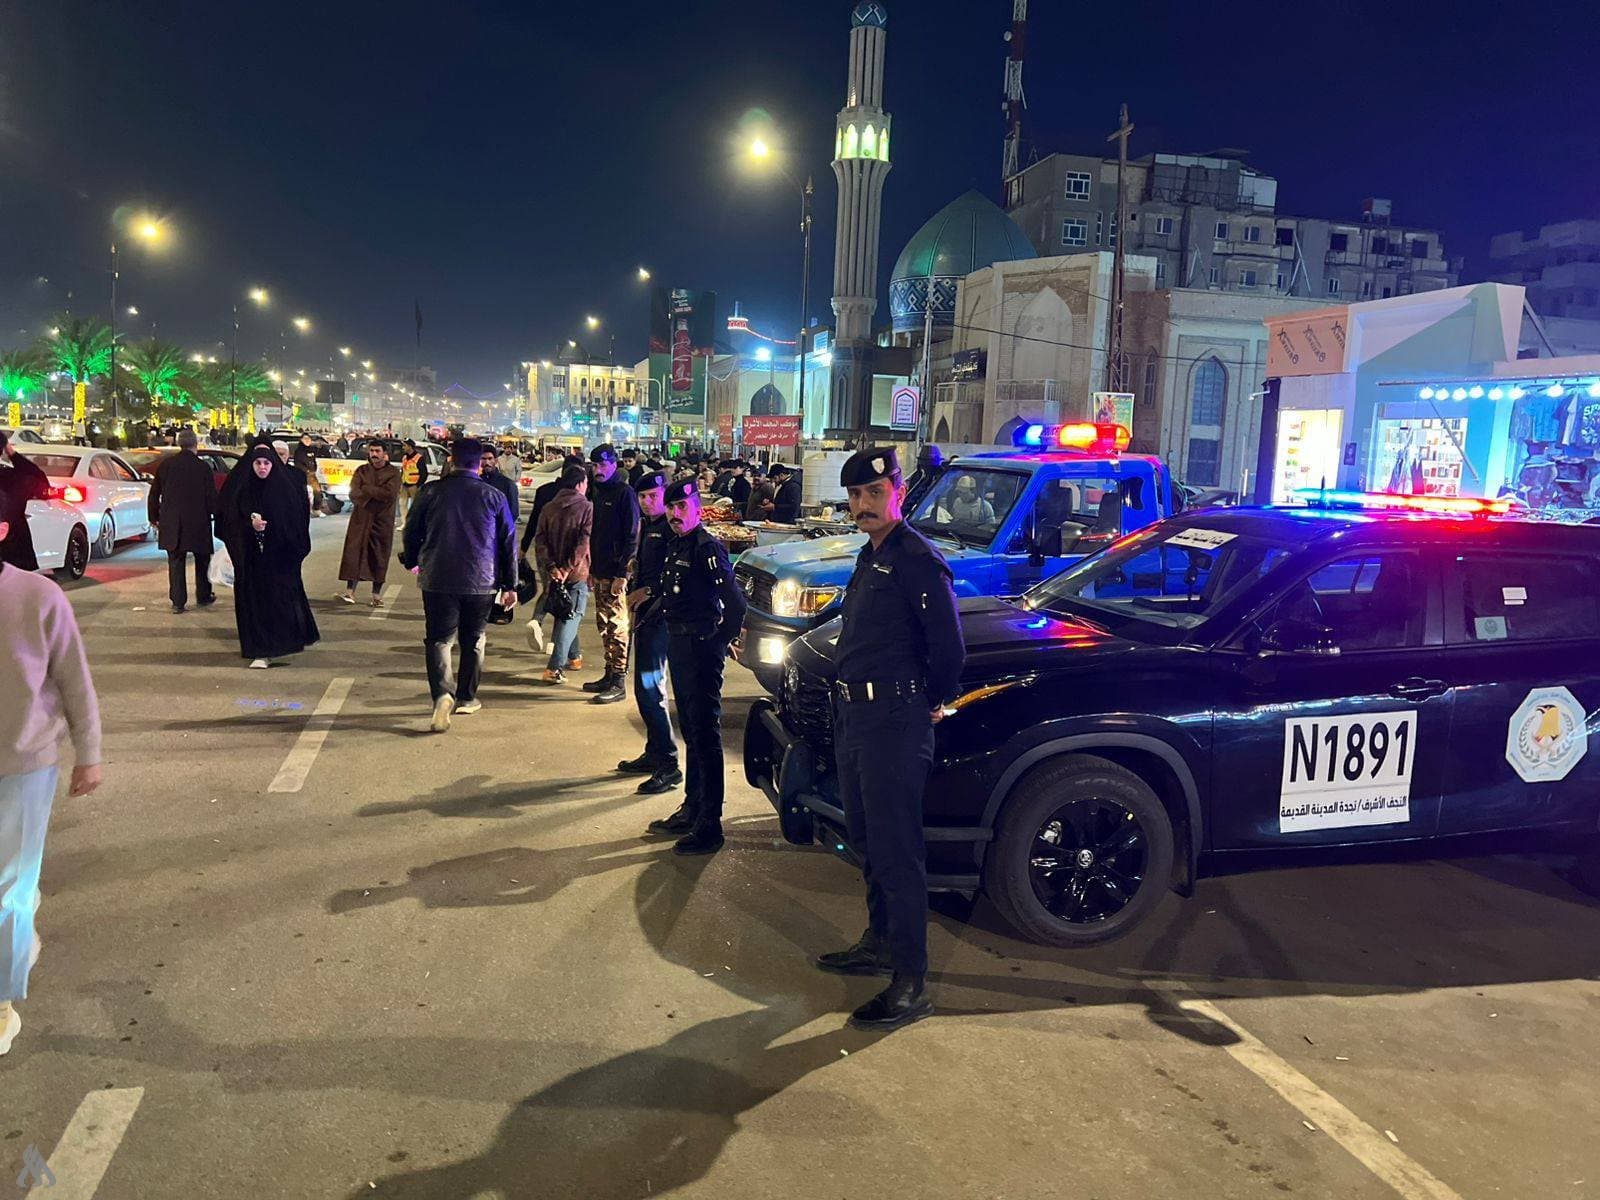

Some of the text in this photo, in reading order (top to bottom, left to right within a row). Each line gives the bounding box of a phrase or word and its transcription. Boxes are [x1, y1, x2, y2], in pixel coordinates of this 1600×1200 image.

[744, 417, 761, 429] الأشرف
[763, 419, 779, 428] النجف
[1290, 720, 1409, 782] N1891
[1311, 802, 1338, 818] المدينة
[1387, 795, 1407, 811] النجف
[1281, 804, 1310, 820] القديمة
